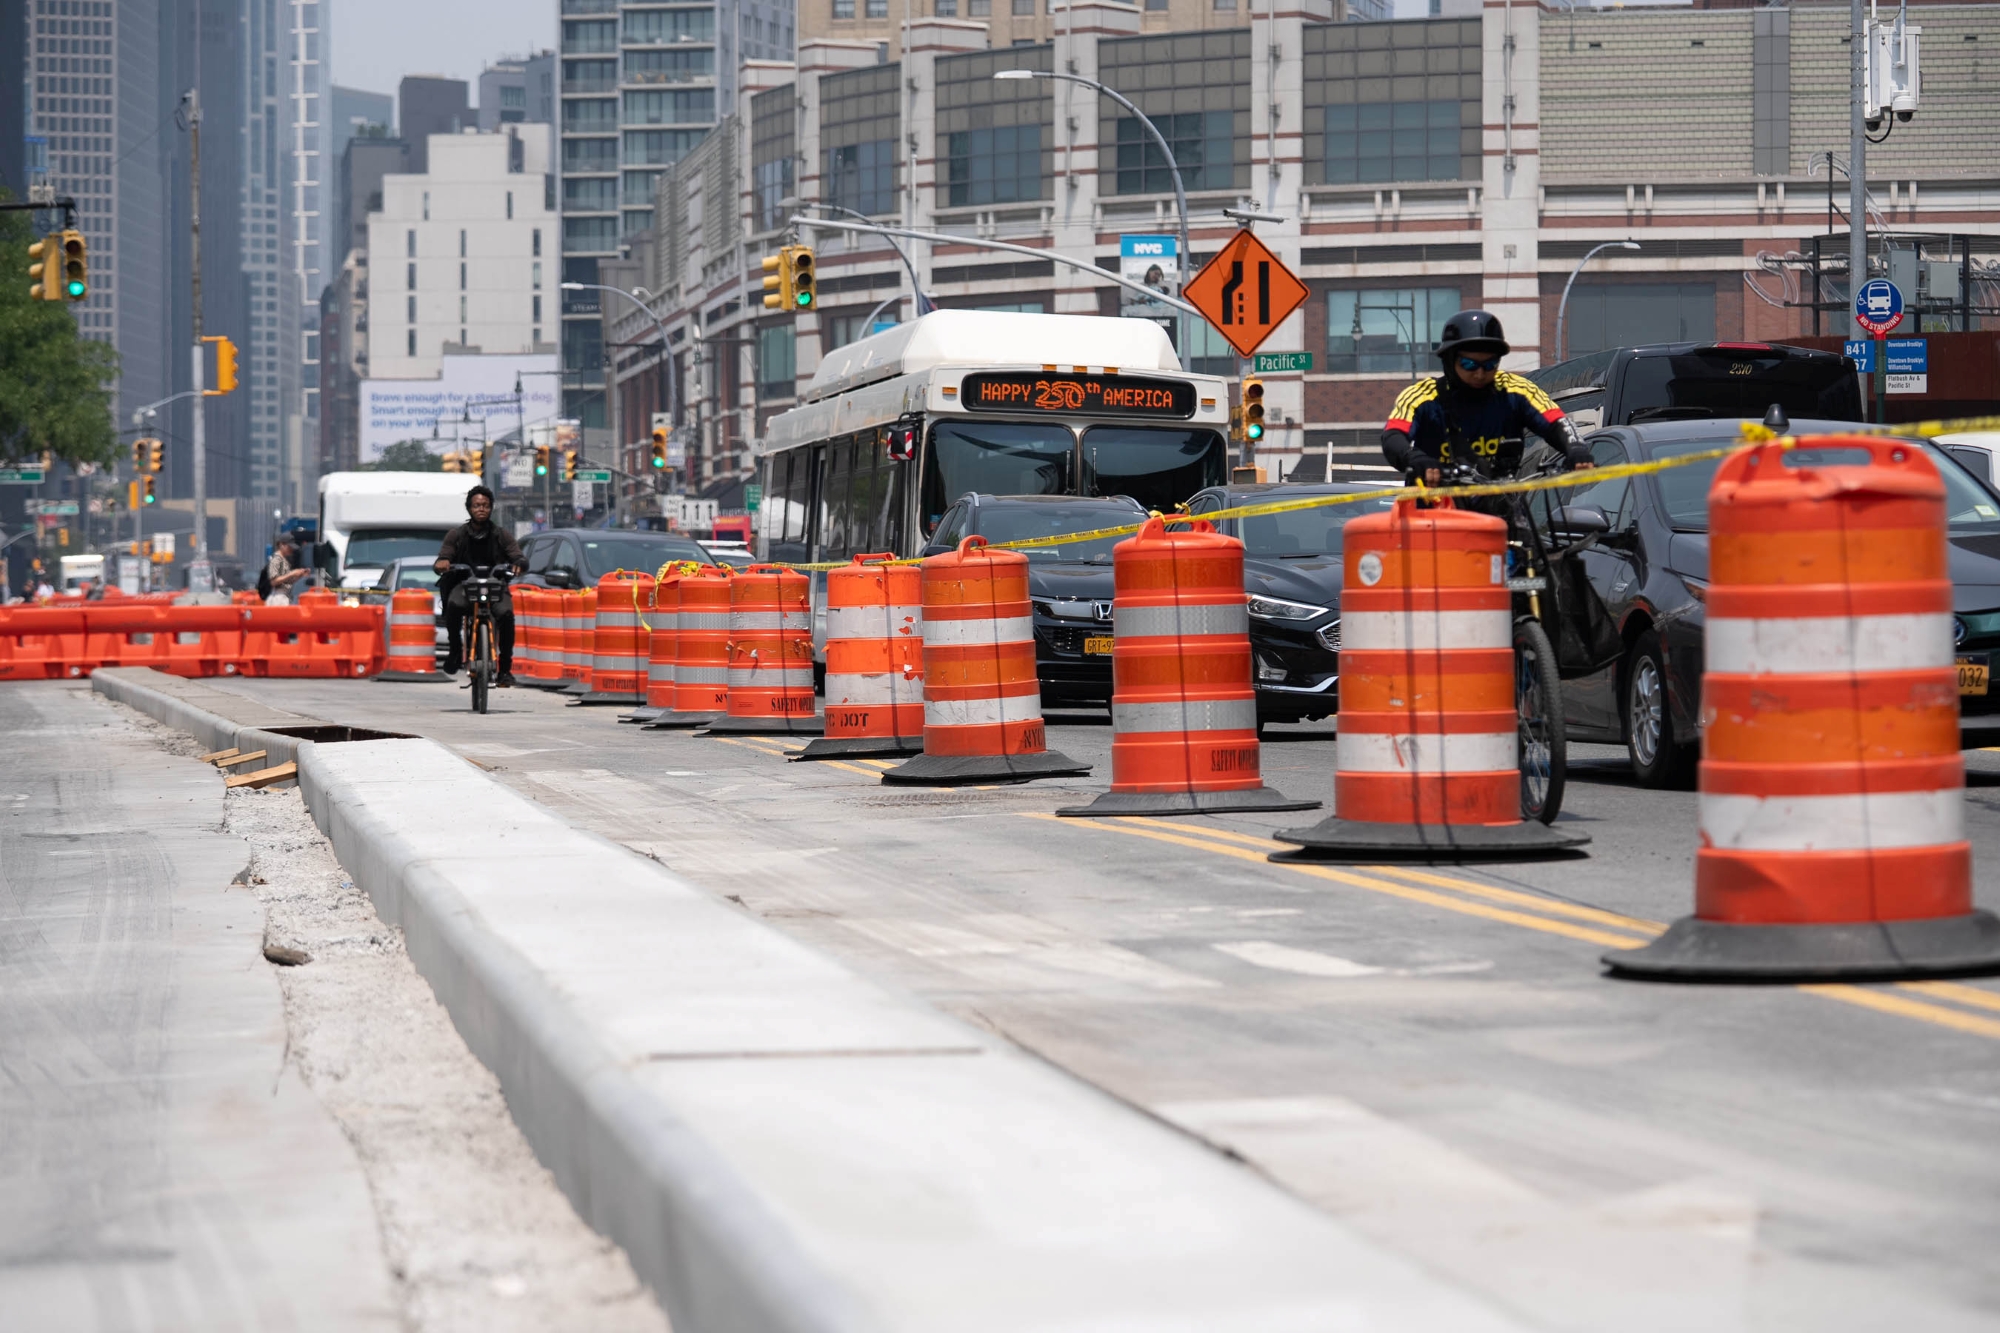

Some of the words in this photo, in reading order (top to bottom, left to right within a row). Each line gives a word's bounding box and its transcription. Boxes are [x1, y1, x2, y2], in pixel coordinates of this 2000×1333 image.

[1133, 243, 1163, 254] NYC
[1859, 316, 1868, 326] NO
[1869, 315, 1900, 330] STANDING
[1846, 343, 1866, 355] B41
[1260, 356, 1296, 371] Pacific
[404, 393, 446, 404] enough
[981, 382, 1032, 401] HAPPY
[1103, 388, 1173, 408] AMERICA
[372, 406, 404, 414] Smart
[407, 406, 446, 416] enough
[372, 419, 386, 427] on
[389, 419, 414, 429] your
[771, 697, 798, 711] SAFETY
[840, 712, 869, 727] DOT
